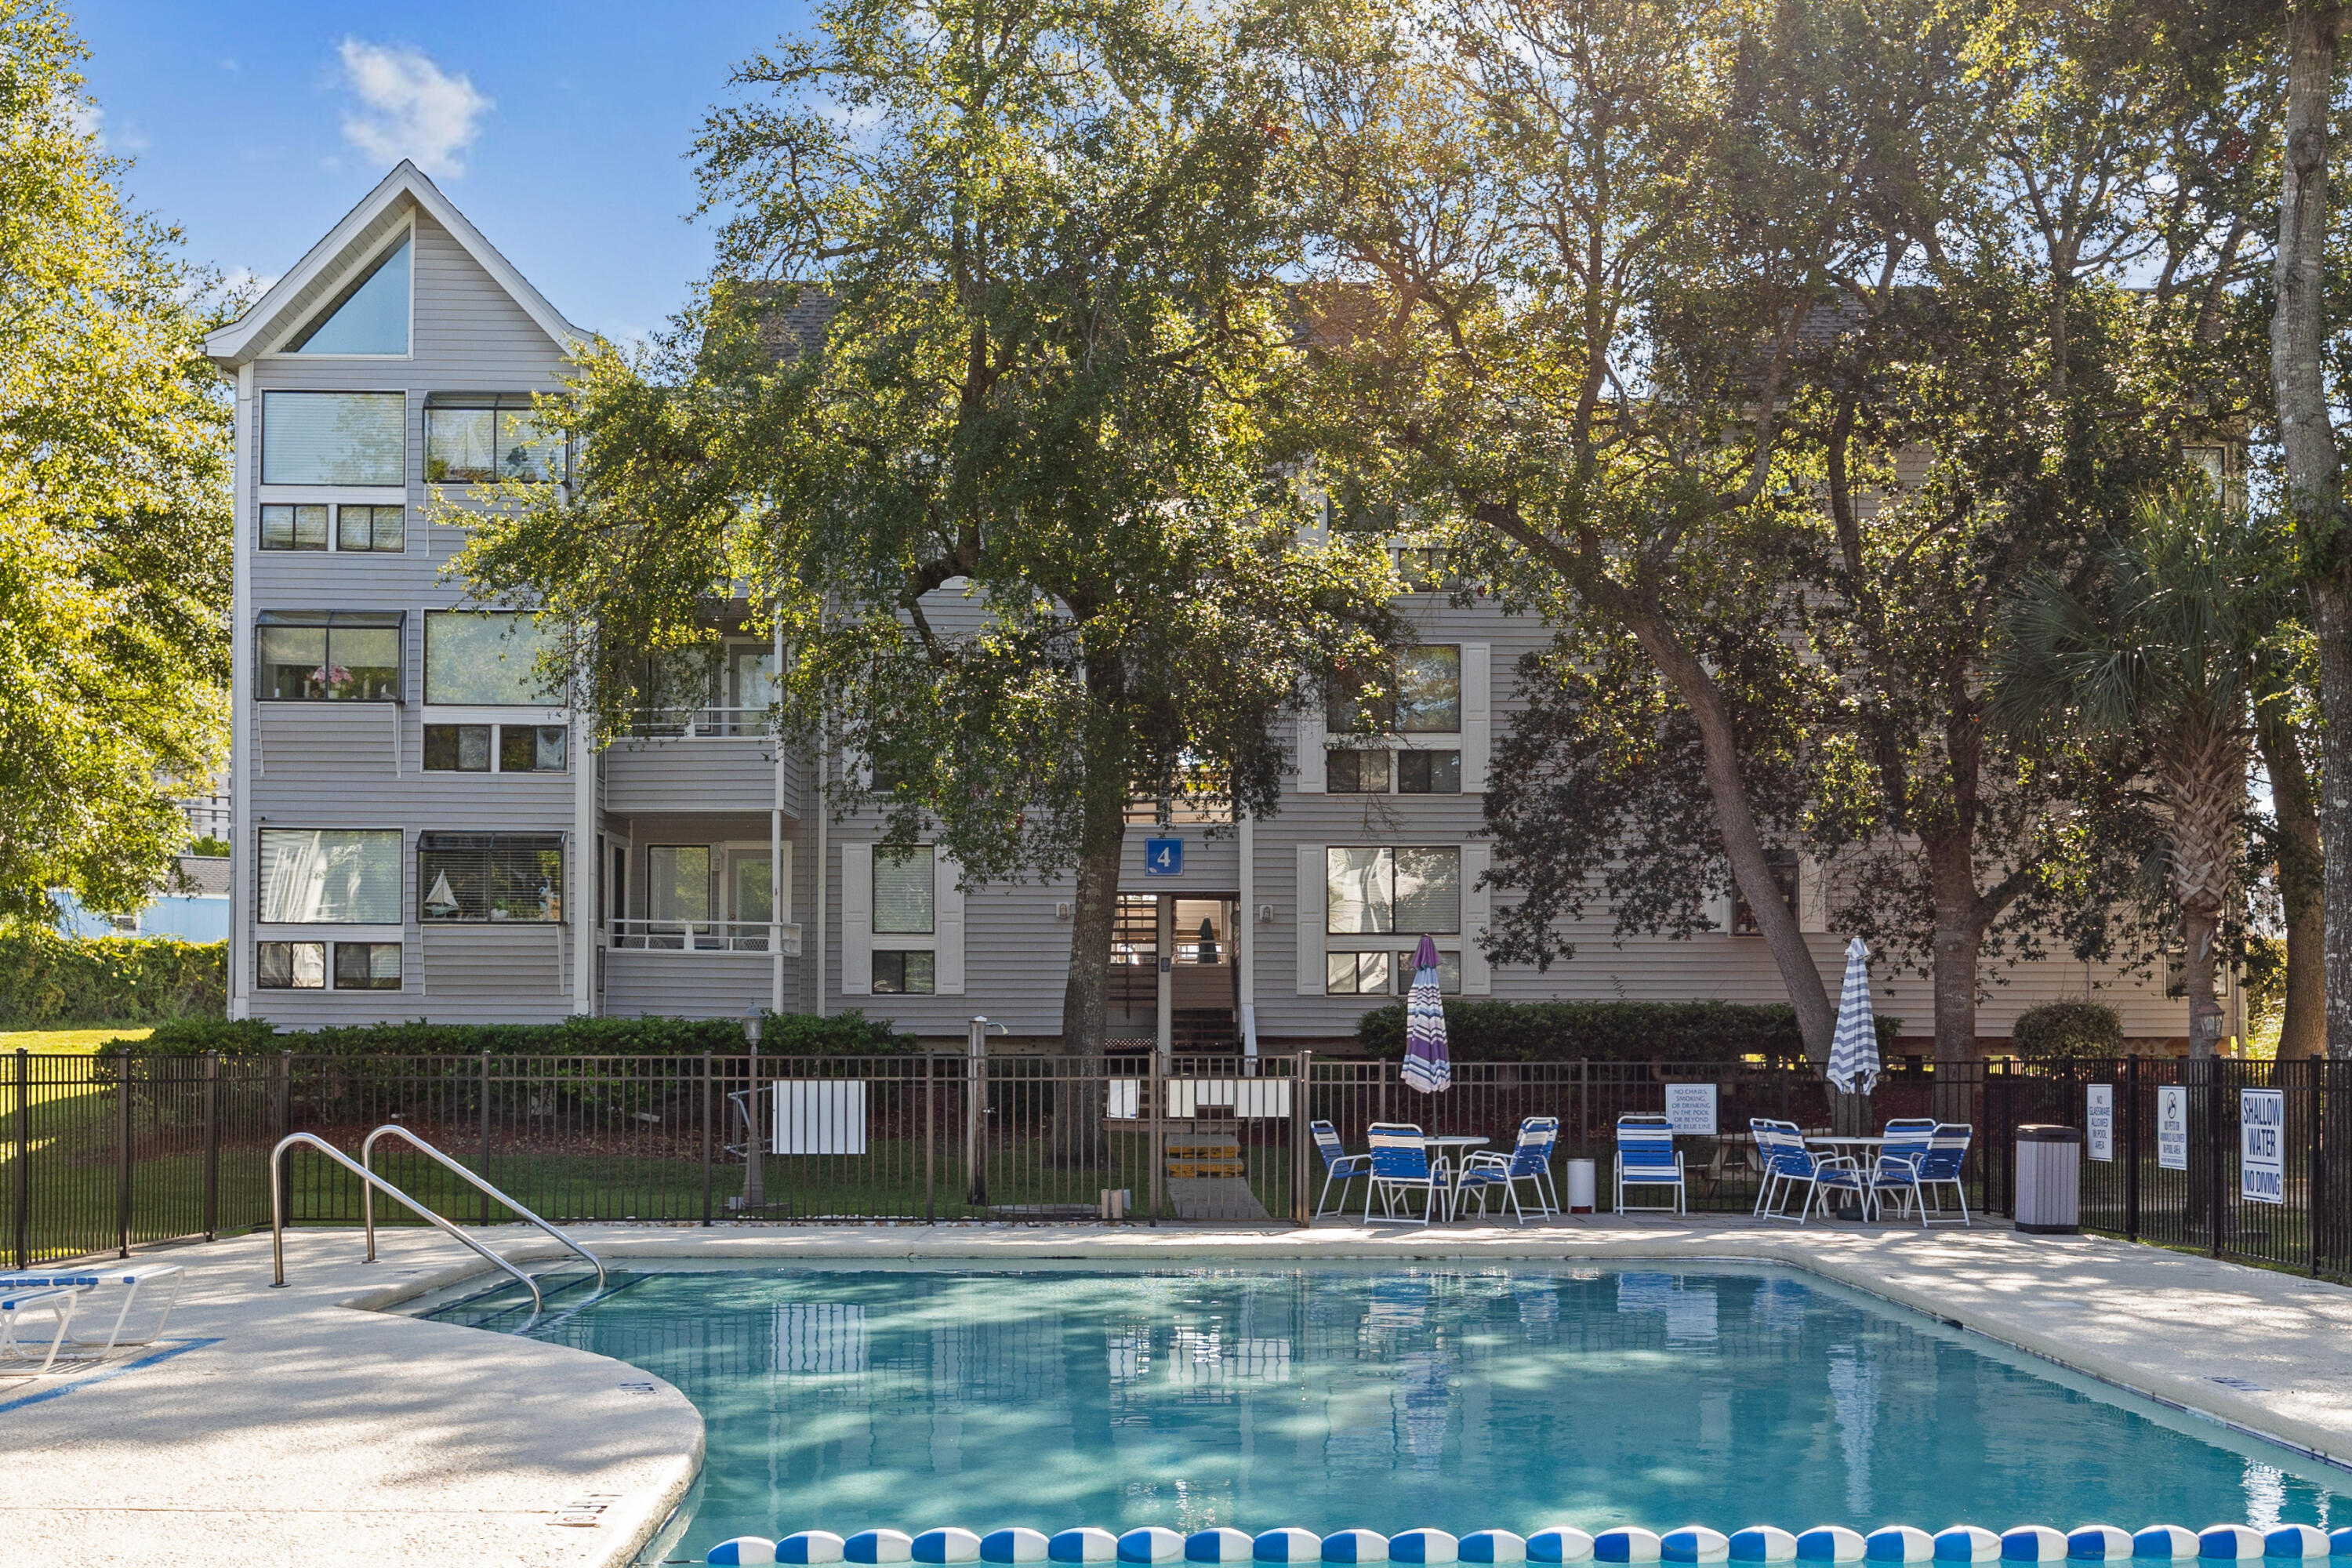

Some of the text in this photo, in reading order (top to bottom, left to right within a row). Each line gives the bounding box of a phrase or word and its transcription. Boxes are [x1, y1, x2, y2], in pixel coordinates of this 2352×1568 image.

[1157, 847, 1171, 867] 4
[2096, 1095, 2103, 1105] NO
[2089, 1106, 2111, 1116] GLASSWARE
[2243, 1097, 2281, 1127] SHALLOW
[2091, 1118, 2109, 1127] ALLOWED
[2097, 1129, 2107, 1138] POOL
[2095, 1140, 2105, 1150] AREA
[2248, 1127, 2276, 1157] WATER
[2245, 1170, 2280, 1196] NO DIVING
